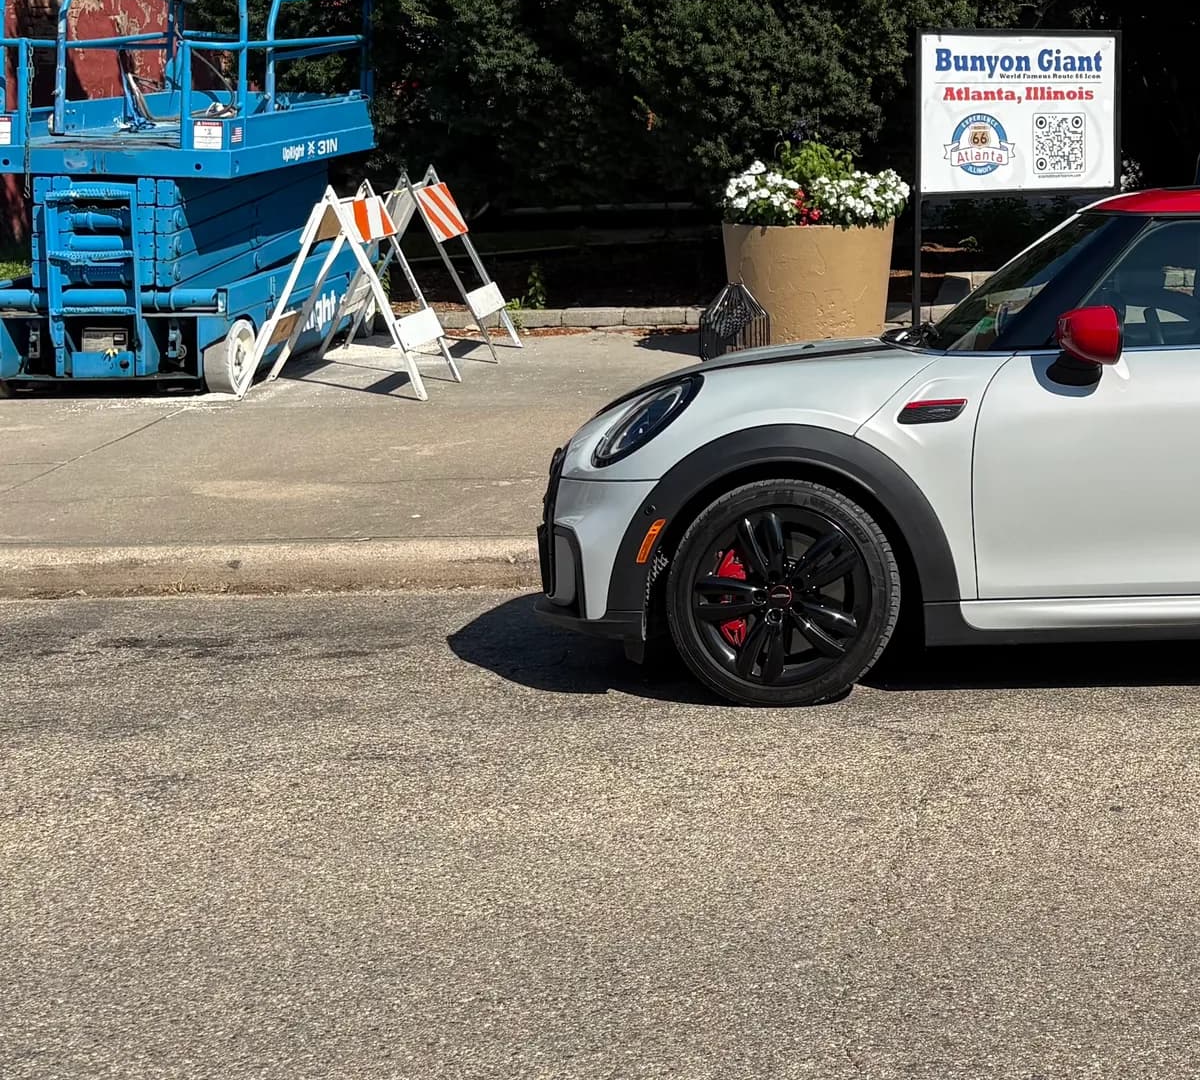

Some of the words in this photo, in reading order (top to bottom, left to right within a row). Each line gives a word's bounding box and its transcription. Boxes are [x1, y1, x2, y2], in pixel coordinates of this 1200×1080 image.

[935, 48, 1031, 79] Bunyon
[1037, 48, 1102, 72] Giant
[999, 72, 1021, 80] World
[1022, 72, 1051, 80] Famous
[1052, 72, 1074, 80] Route
[1075, 72, 1084, 80] 66
[1084, 72, 1102, 80] Icon
[943, 87, 1022, 104] Atlanta,
[1025, 86, 1094, 101] Illinois
[317, 137, 338, 156] 31N
[972, 132, 988, 145] 66
[957, 150, 1004, 164] Atlanta
